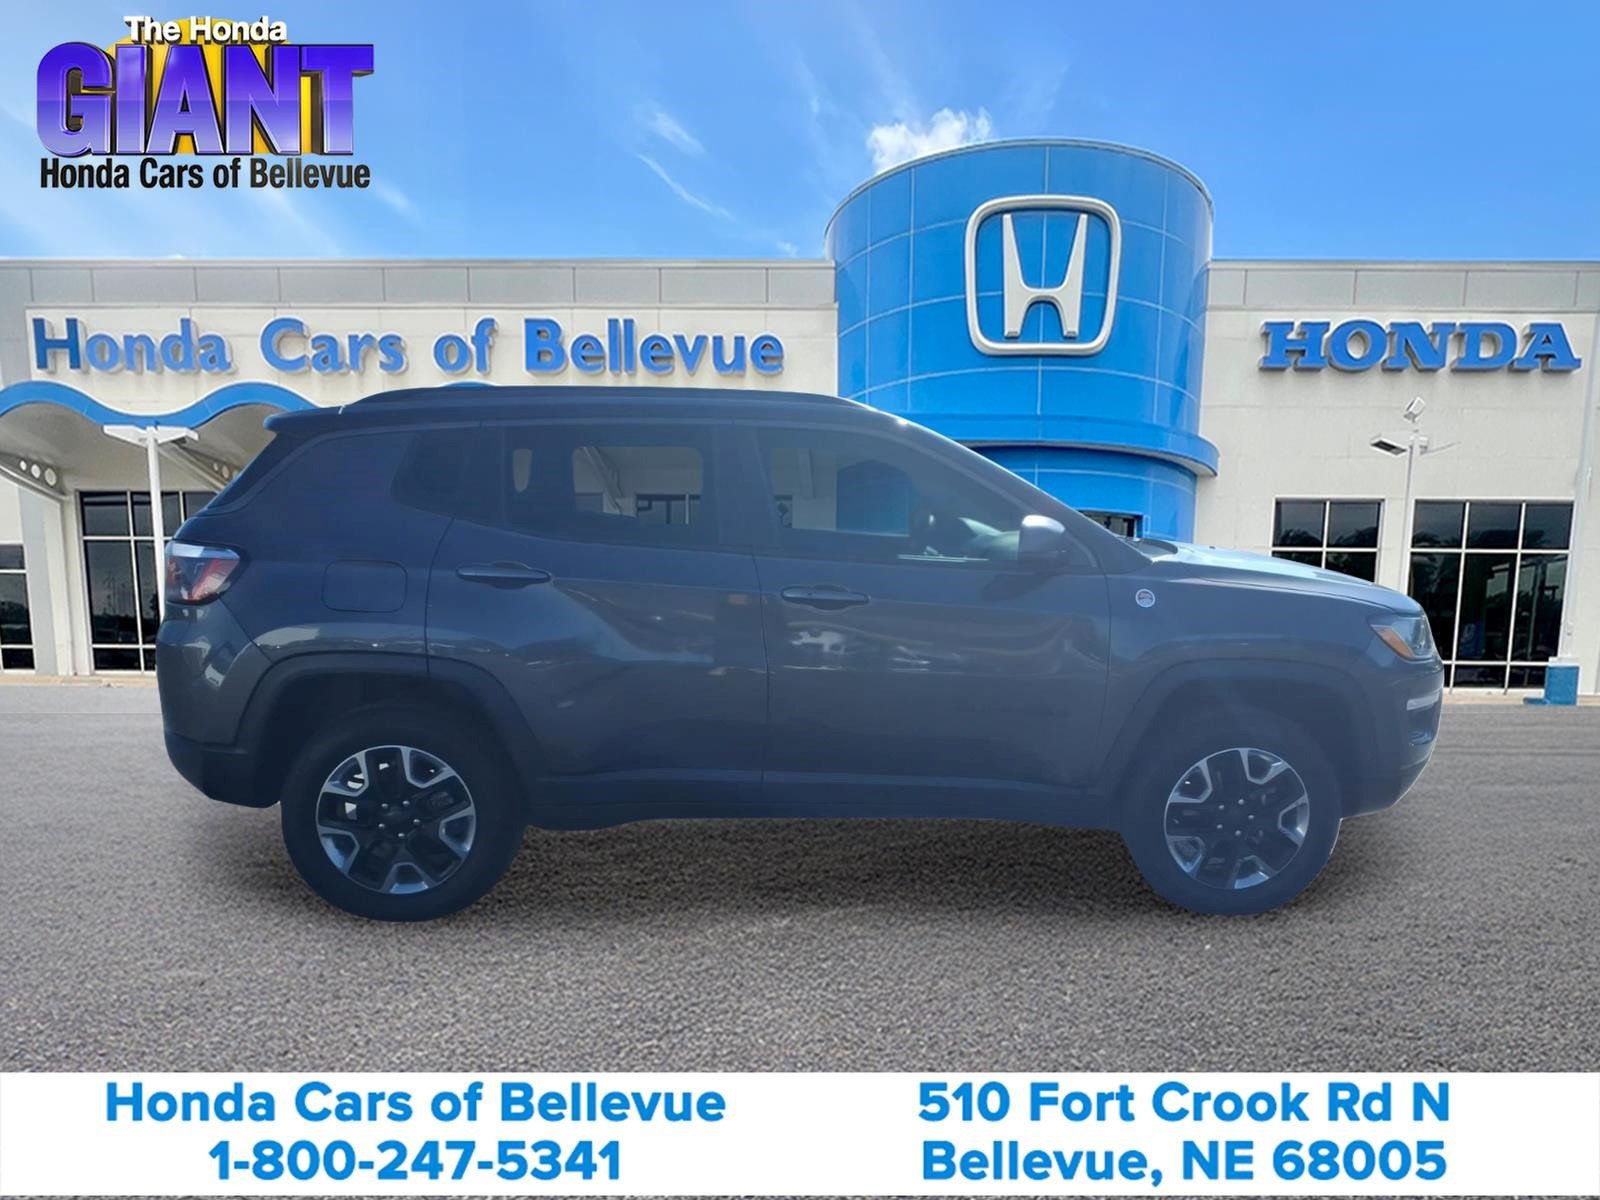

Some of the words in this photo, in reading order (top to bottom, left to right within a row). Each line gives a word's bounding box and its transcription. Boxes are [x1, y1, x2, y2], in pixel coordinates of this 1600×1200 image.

[32, 317, 232, 374] Honda
[261, 317, 407, 374] Cars
[433, 317, 497, 374] of
[525, 317, 785, 375] Bellevue
[1259, 319, 1582, 373] HONDA
